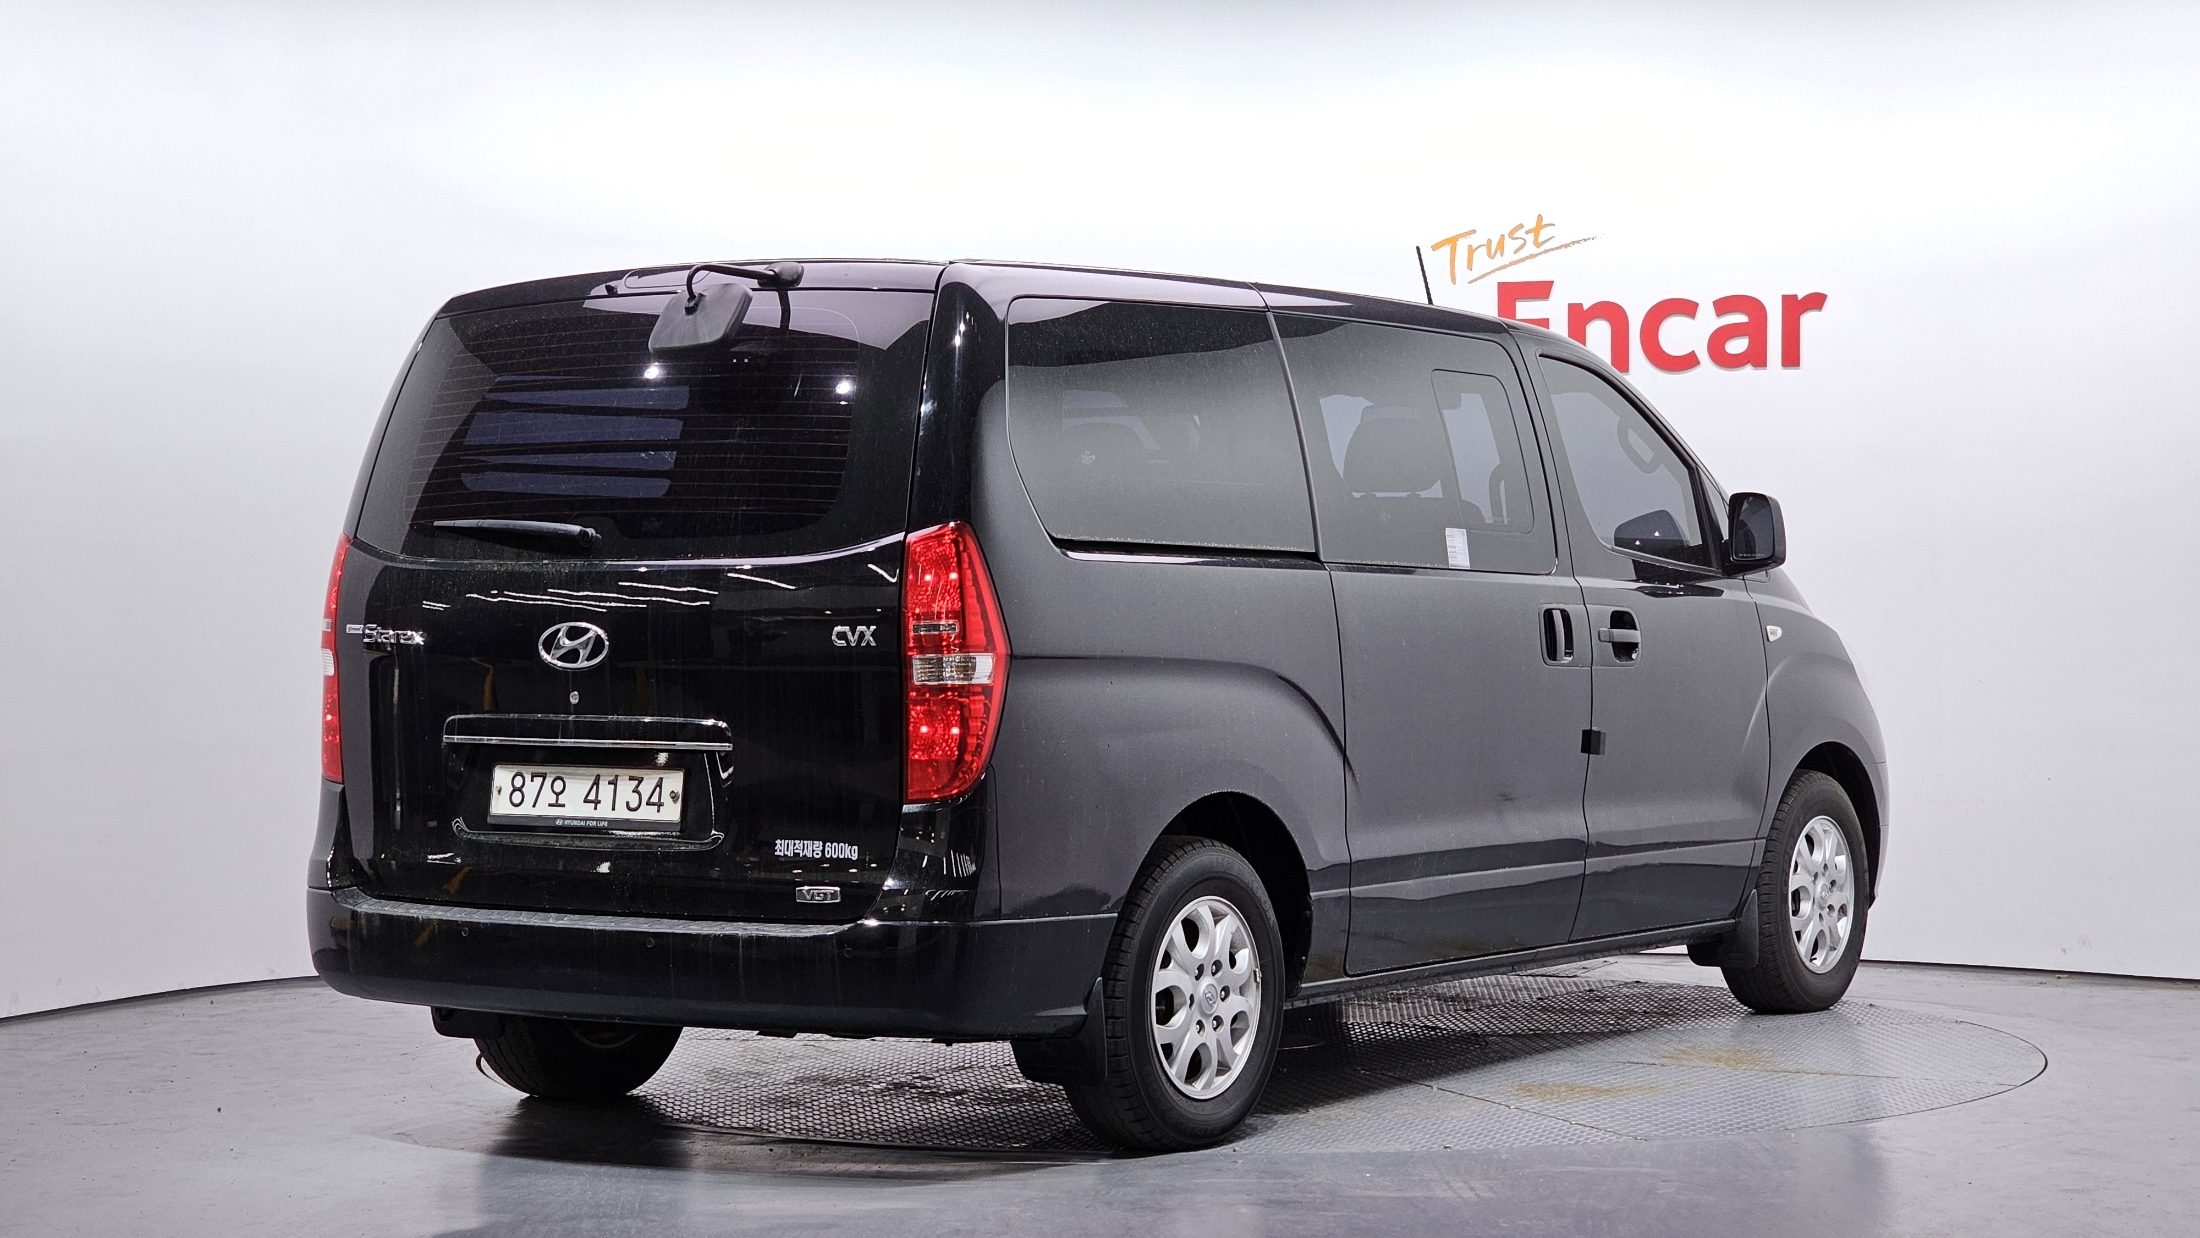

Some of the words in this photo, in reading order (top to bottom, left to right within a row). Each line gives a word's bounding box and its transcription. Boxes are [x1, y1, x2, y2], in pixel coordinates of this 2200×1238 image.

[1431, 214, 1556, 285] Trust
[1498, 280, 1828, 374] Encar
[363, 624, 426, 645] Starex
[831, 625, 877, 646] CVX
[508, 771, 567, 808] 87오
[583, 773, 665, 813] 4134
[774, 839, 823, 858] 최대적재량
[824, 842, 859, 860] 600kg
[802, 889, 835, 901] VGT
